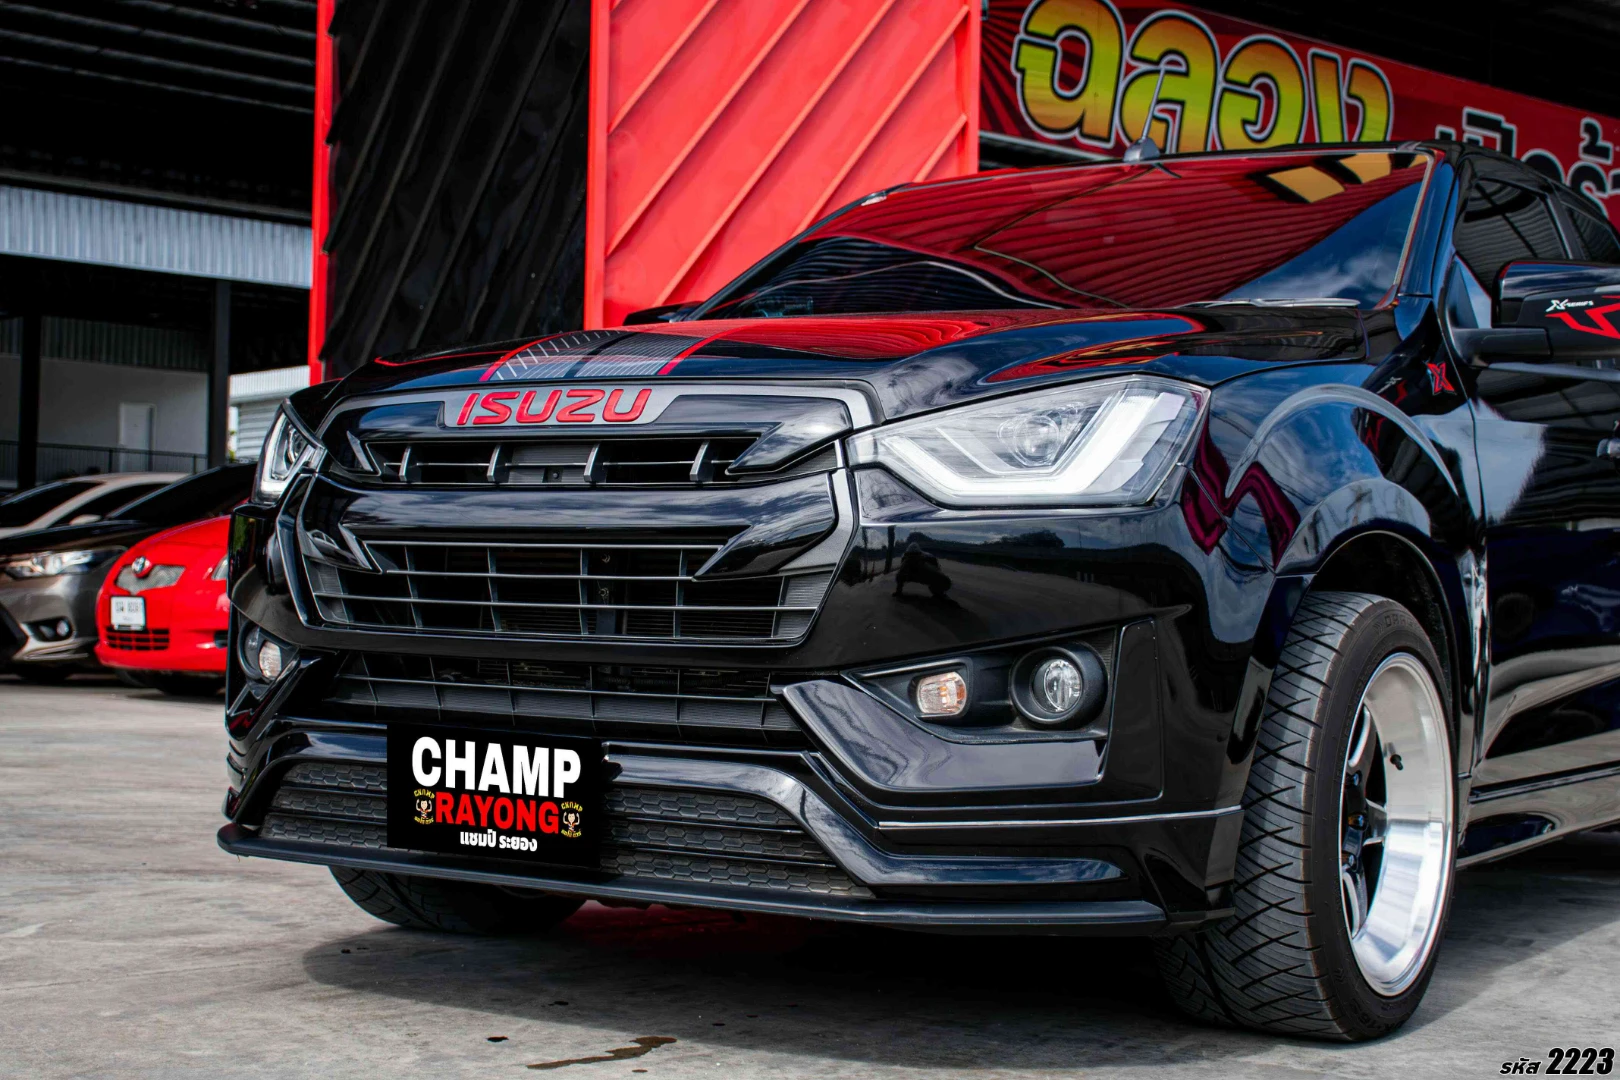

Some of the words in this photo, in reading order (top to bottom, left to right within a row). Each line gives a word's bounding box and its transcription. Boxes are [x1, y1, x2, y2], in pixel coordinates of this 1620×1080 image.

[456, 388, 653, 426] ISUZU
[412, 736, 582, 799] CHAMP
[435, 791, 559, 835] RAYONG
